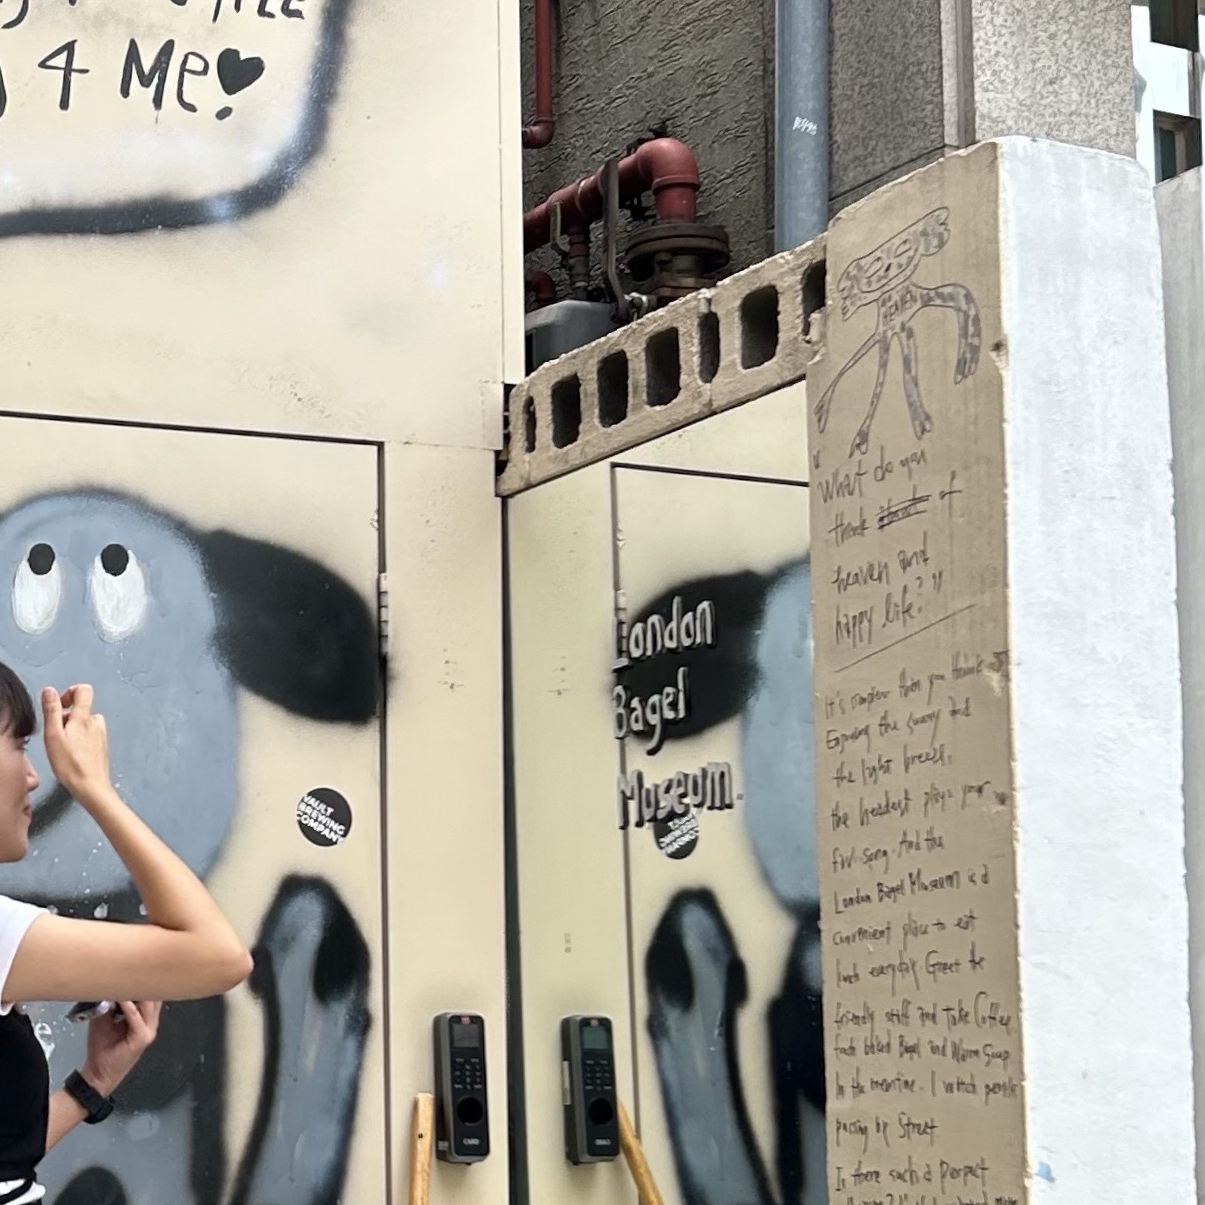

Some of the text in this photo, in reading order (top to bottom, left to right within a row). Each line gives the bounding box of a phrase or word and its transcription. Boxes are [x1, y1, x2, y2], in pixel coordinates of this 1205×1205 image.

[37, 38, 90, 111] 4
[874, 445, 893, 481] do
[899, 448, 927, 481] you
[832, 561, 890, 593] heaven
[613, 594, 717, 672] London
[835, 604, 873, 648] happy
[612, 666, 691, 756] Bagel
[878, 710, 899, 736] the
[832, 761, 855, 788] the
[618, 761, 734, 830] Museum
[298, 802, 345, 835] BREWING
[831, 801, 849, 831] the
[908, 868, 961, 895] Museum
